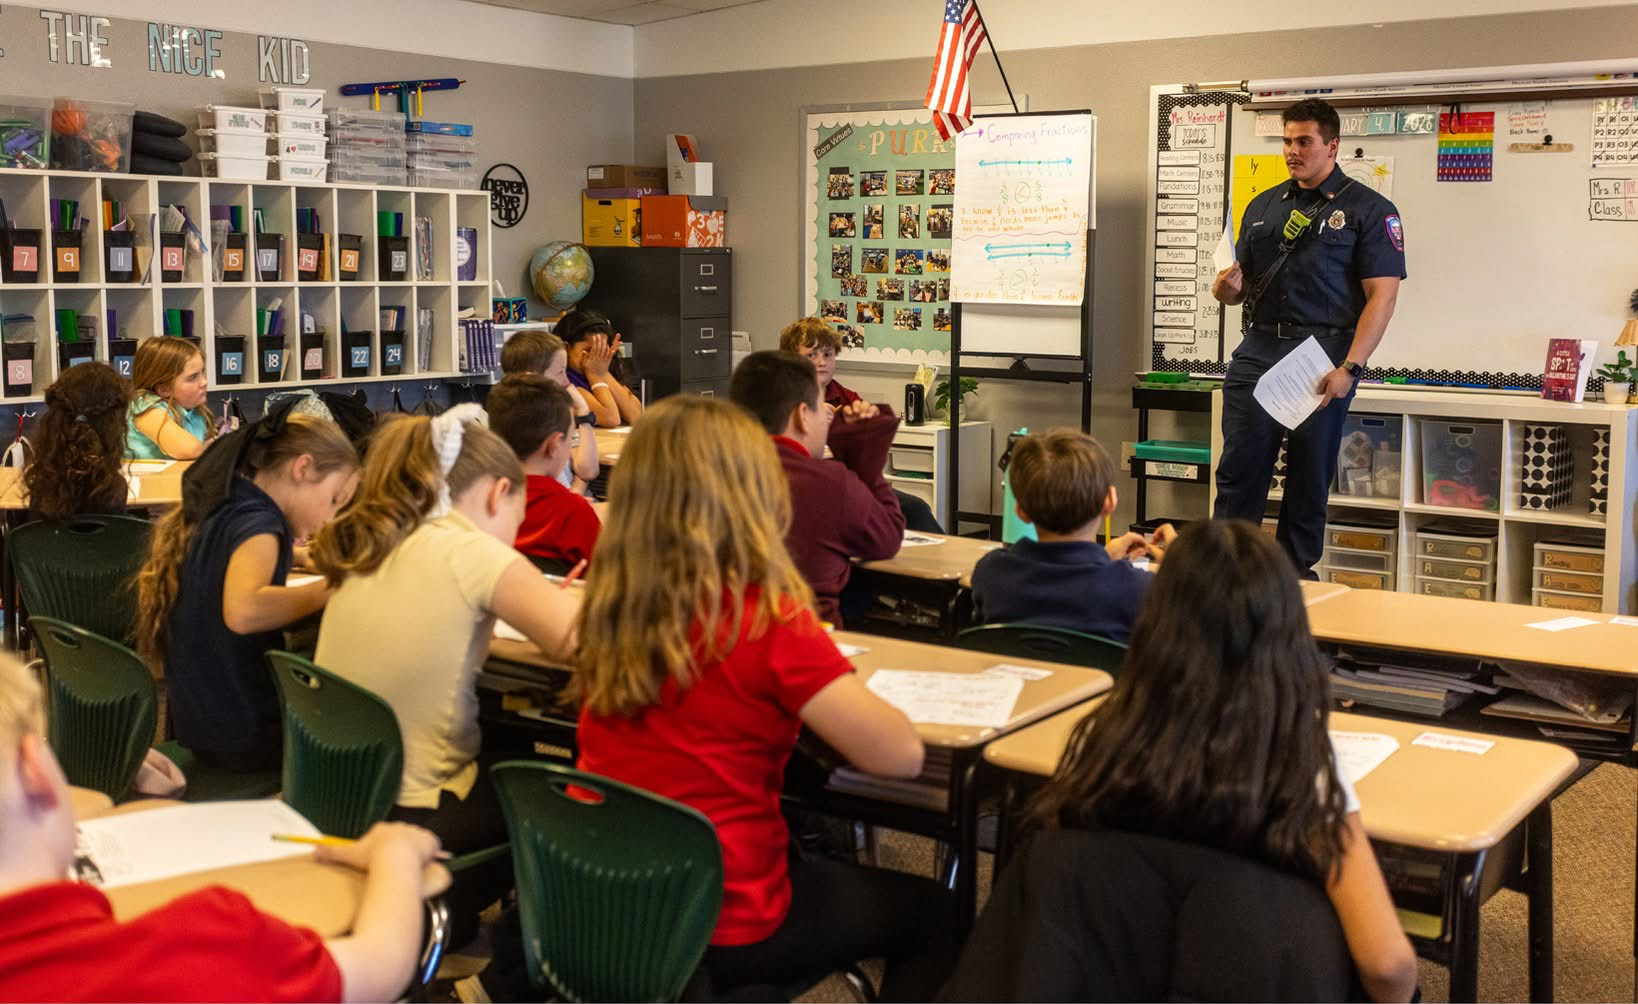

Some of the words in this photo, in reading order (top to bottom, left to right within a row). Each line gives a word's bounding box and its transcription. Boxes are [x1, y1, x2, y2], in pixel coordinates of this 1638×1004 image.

[40, 9, 112, 68] THE
[148, 22, 226, 80] NICE
[258, 35, 311, 85] KID
[987, 122, 1037, 145] Comparing
[1040, 122, 1089, 137] Fractions
[815, 142, 832, 158] Core
[830, 127, 853, 147] Virtues
[1250, 157, 1259, 175] ly
[480, 178, 526, 195] never
[1593, 181, 1609, 196] Mrs
[1613, 181, 1621, 195] R
[1160, 201, 1195, 210] Grammar
[1594, 200, 1623, 217] Class
[498, 207, 519, 225] up
[1167, 218, 1188, 226] Music
[1167, 235, 1188, 243] Lunch
[21, 251, 30, 267] 7
[63, 252, 74, 268] 9
[118, 252, 125, 267] 11
[167, 252, 179, 267] 13
[228, 253, 240, 267] 15
[263, 253, 273, 266] 17
[302, 254, 314, 268] 19
[345, 254, 354, 268] 21
[393, 255, 405, 268] 23
[1166, 250, 1185, 259] Math
[1163, 283, 1188, 292] Recess
[1161, 315, 1187, 323] Science
[268, 354, 279, 368] 18
[306, 354, 321, 366] 20
[354, 351, 367, 364] 22
[387, 349, 401, 362] 24
[119, 360, 130, 376] 12
[226, 357, 238, 370] 16
[15, 364, 25, 380] 8
